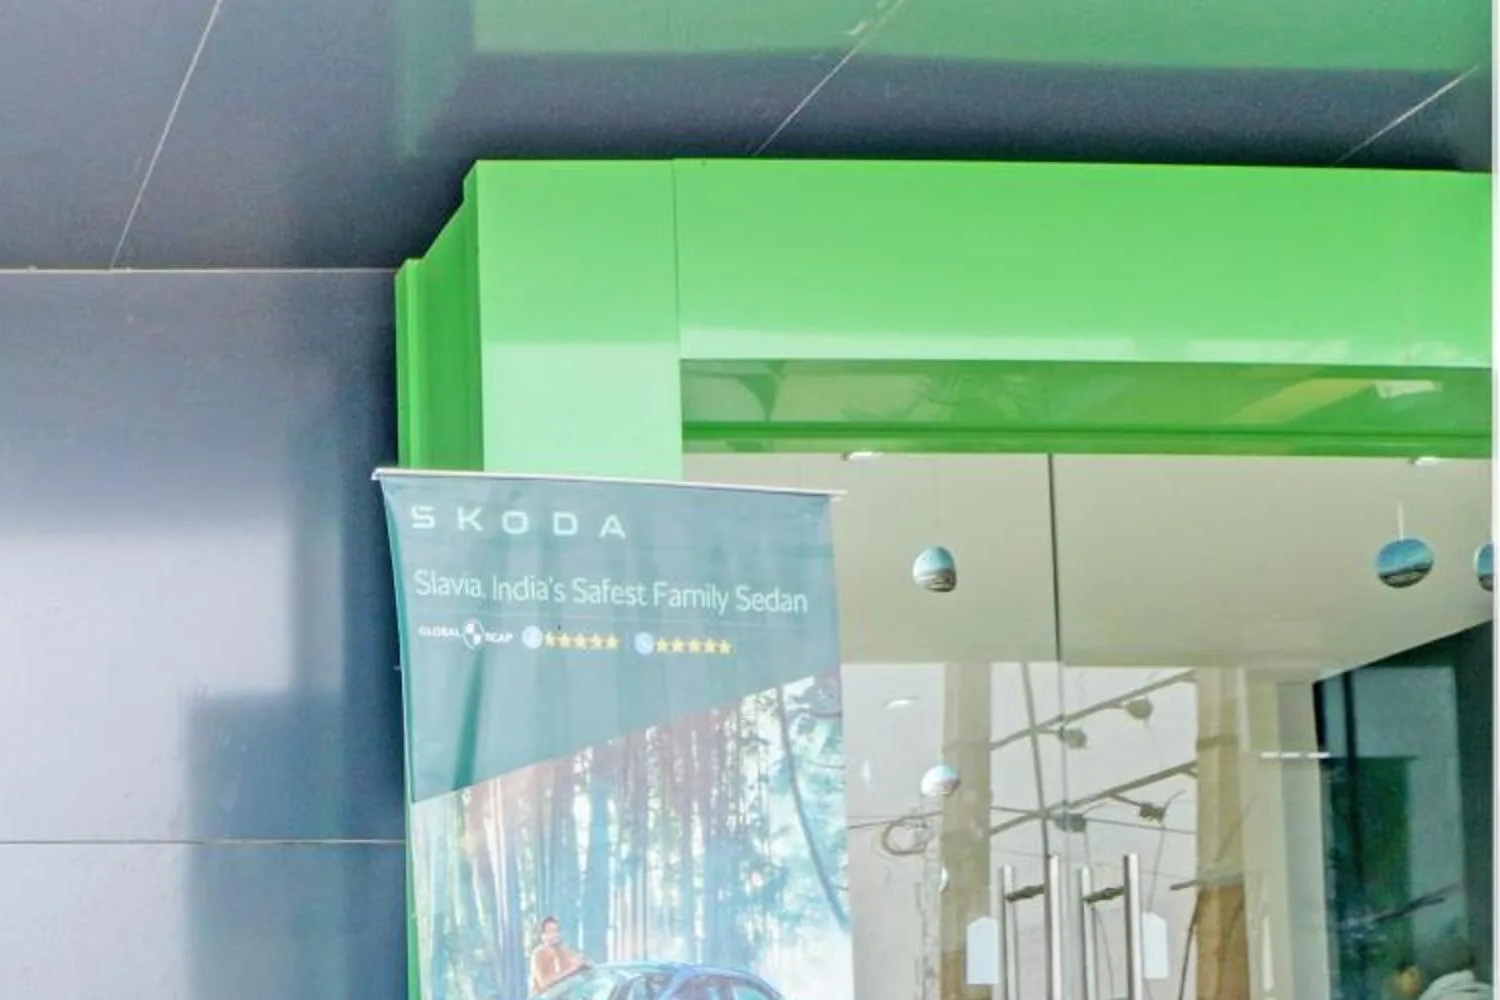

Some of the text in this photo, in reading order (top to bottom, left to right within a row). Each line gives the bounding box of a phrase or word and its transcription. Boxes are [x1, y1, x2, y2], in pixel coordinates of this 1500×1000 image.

[492, 573, 567, 603] India's
[571, 576, 648, 607] Safest
[652, 580, 730, 617] Family
[735, 584, 809, 614] Sedan
